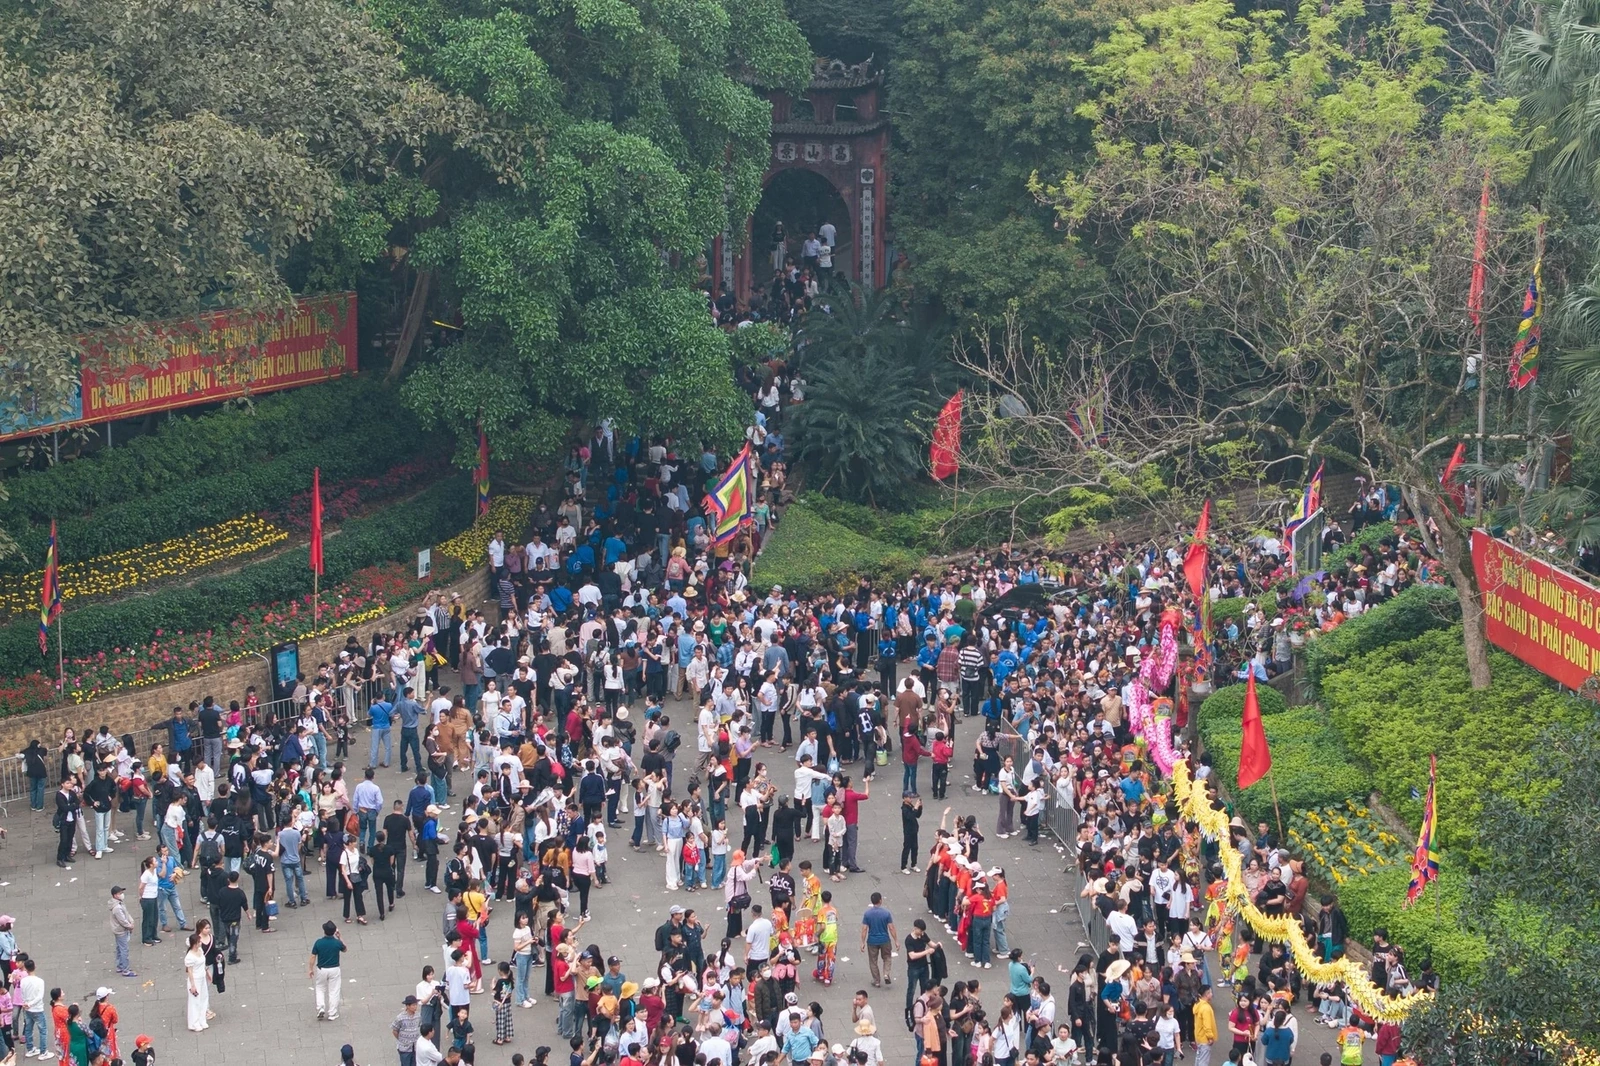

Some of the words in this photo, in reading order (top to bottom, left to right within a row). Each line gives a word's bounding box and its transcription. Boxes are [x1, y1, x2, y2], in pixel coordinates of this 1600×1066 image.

[293, 311, 311, 338] PHÚ
[91, 386, 102, 411] DI
[152, 370, 172, 399] HÓA
[174, 366, 191, 396] PHI
[277, 345, 295, 376] CỦA
[298, 345, 323, 373] NHÂN
[1521, 567, 1537, 600] VUA
[1540, 575, 1564, 615] HÙNG
[1566, 589, 1579, 623] ĐÃ
[1581, 597, 1593, 630] CÓ
[1505, 602, 1527, 636] CHÁU
[1529, 613, 1539, 643] TA
[1541, 619, 1562, 656] PHẢI
[1564, 631, 1589, 672] CÙNG
